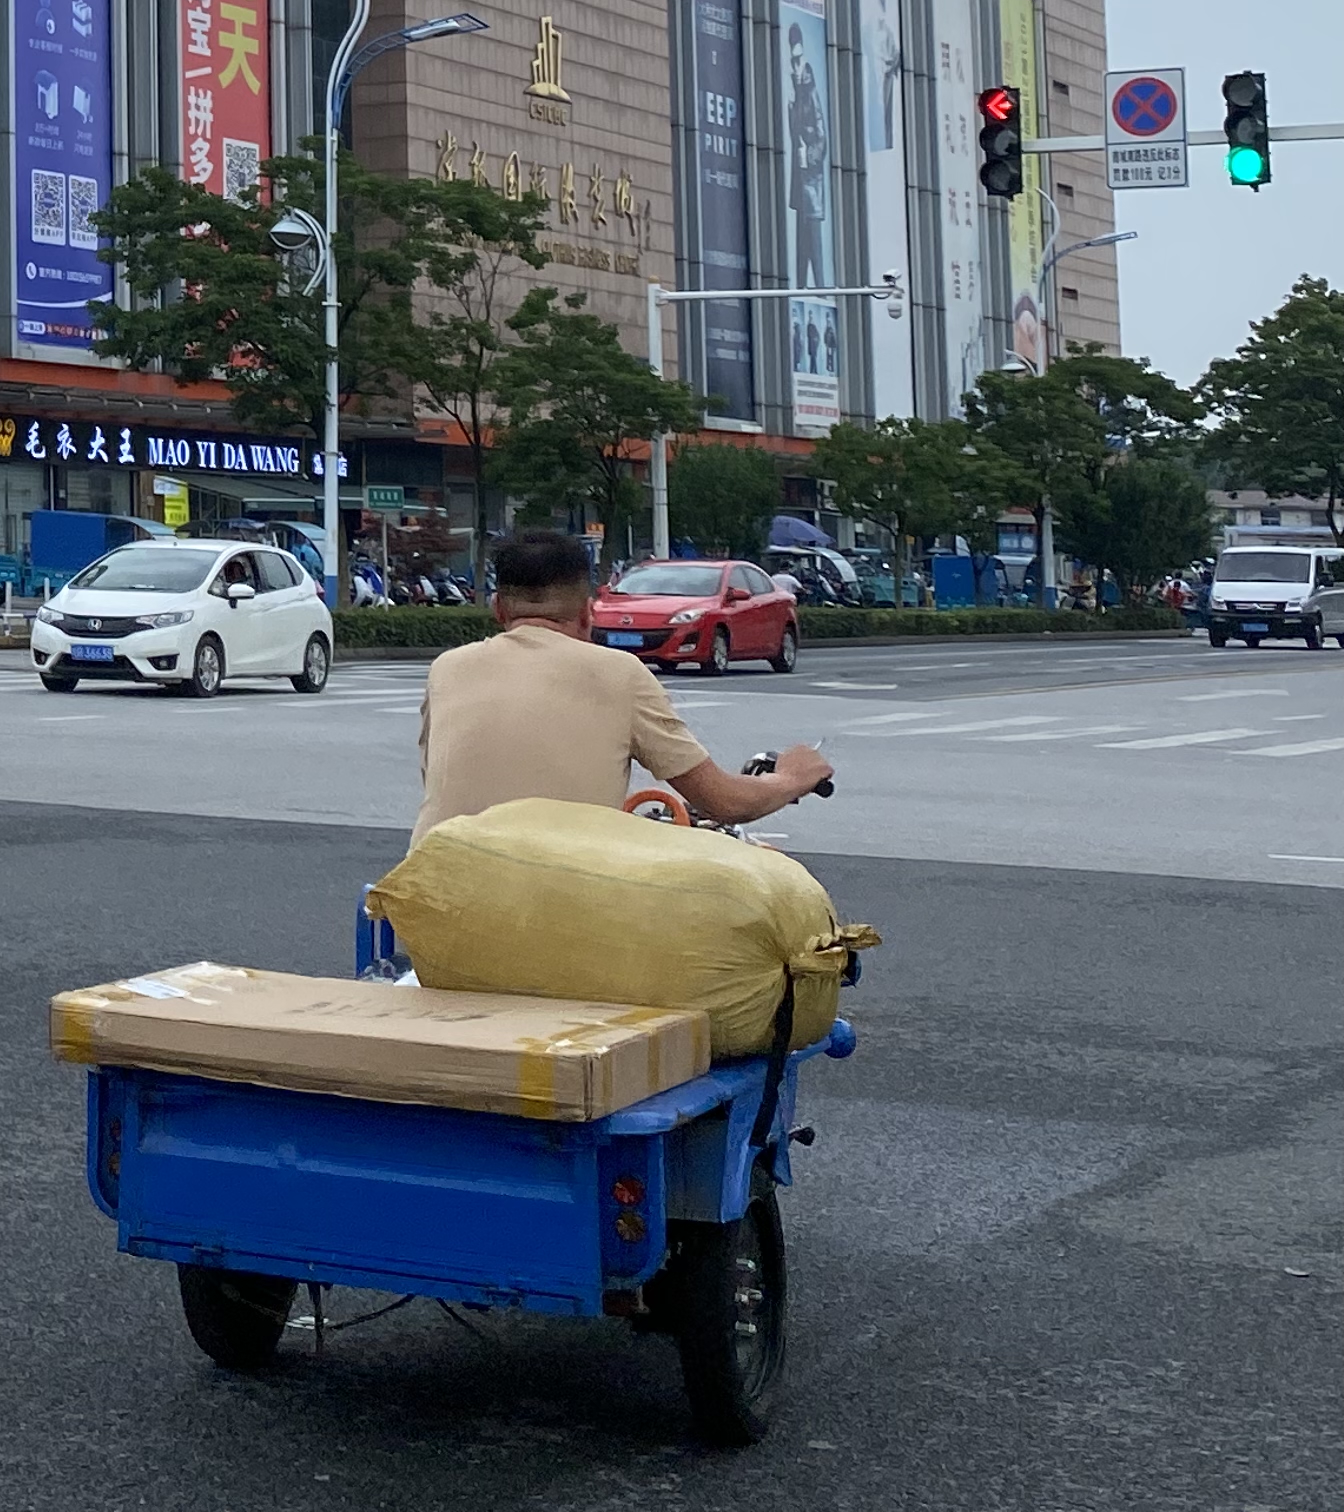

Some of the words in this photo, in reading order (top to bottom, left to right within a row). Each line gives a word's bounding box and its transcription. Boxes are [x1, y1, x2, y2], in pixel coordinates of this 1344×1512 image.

[25, 421, 135, 465] 毛衣大王
[148, 437, 190, 467] MAO
[196, 440, 216, 469] YI
[223, 443, 247, 471] DA
[251, 446, 299, 474] WANG
